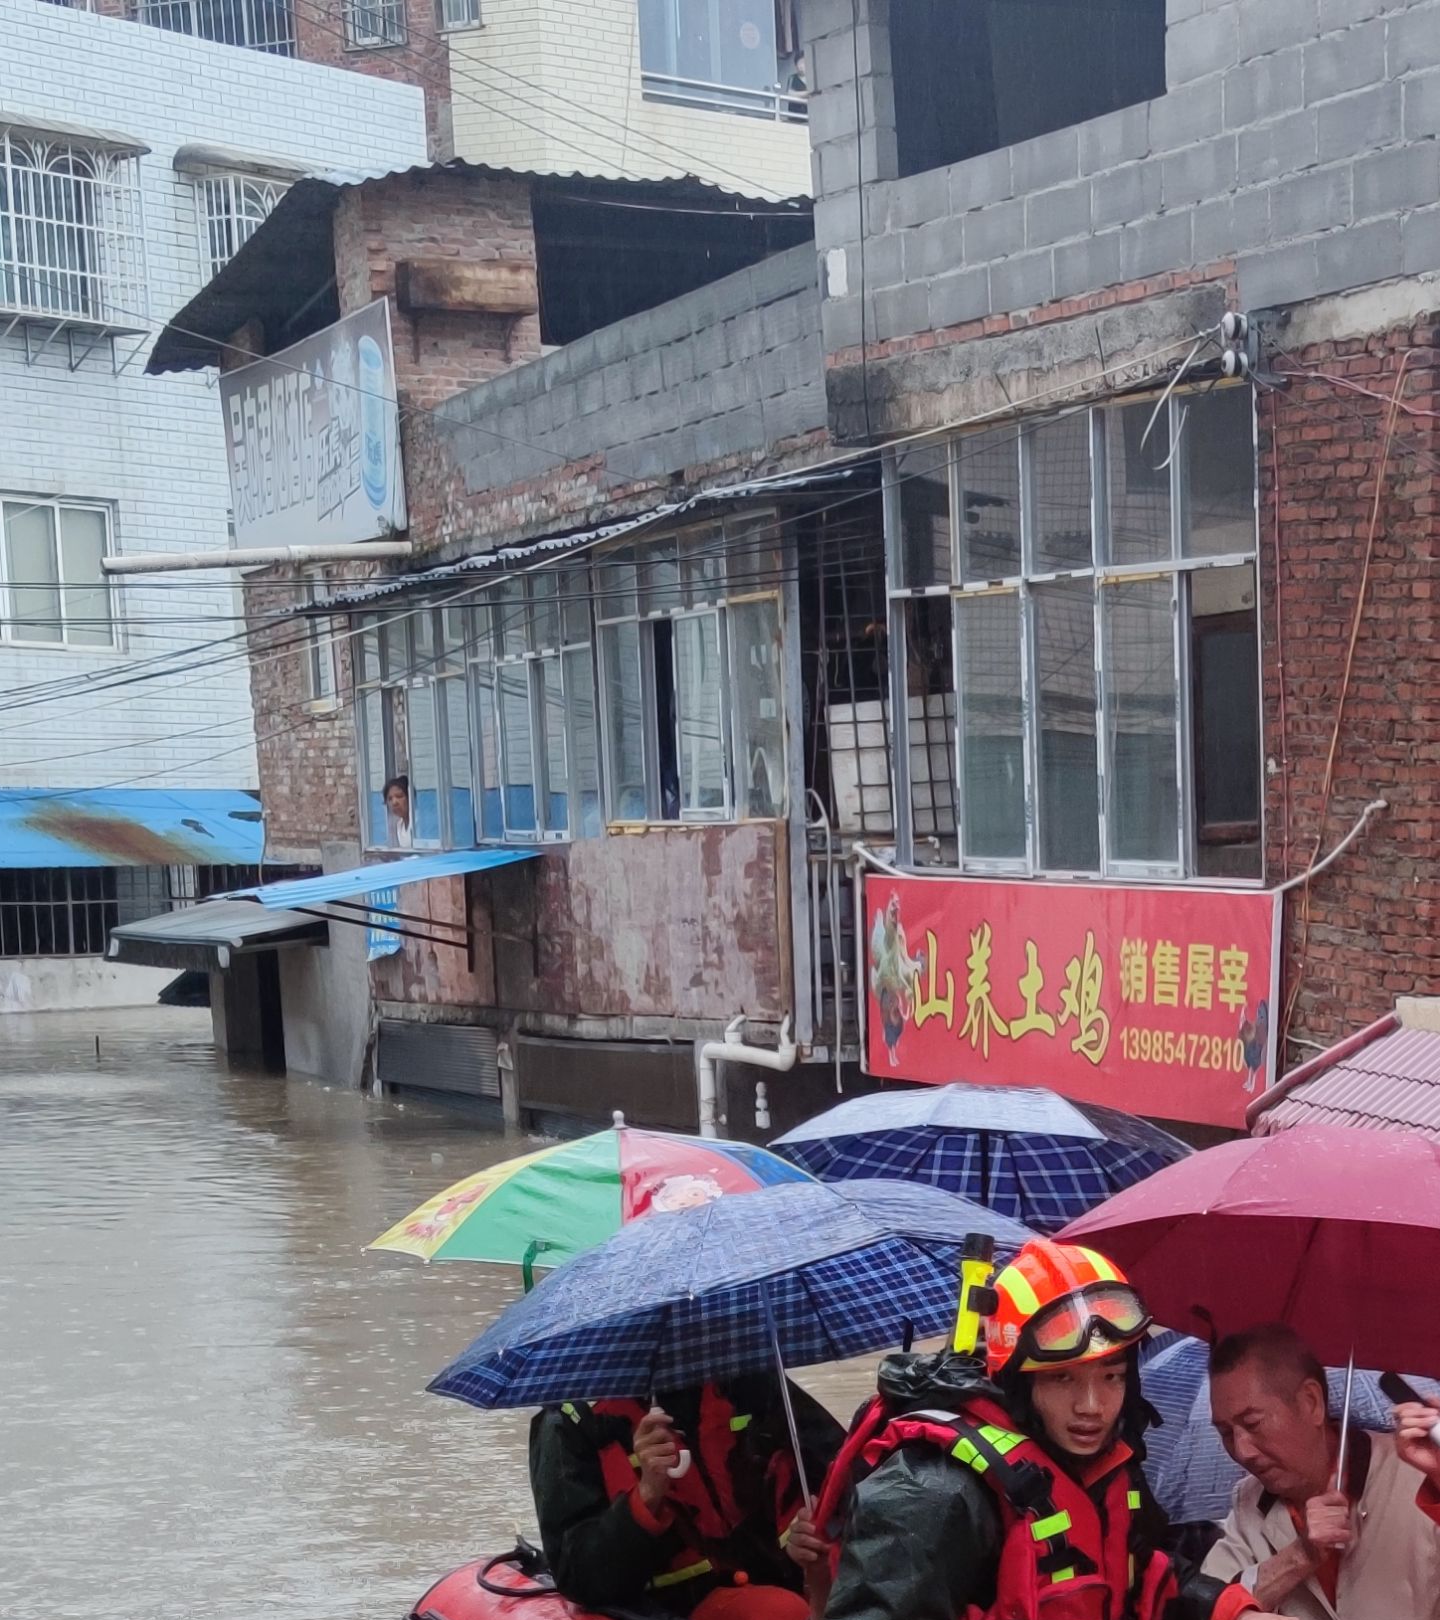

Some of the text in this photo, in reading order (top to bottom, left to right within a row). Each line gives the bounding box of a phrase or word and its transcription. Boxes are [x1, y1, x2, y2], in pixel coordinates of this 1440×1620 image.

[913, 919, 1111, 1065] 山养土鸡
[1119, 936, 1249, 1014] 销售屠宰
[1119, 1026, 1245, 1073] 13985472810
